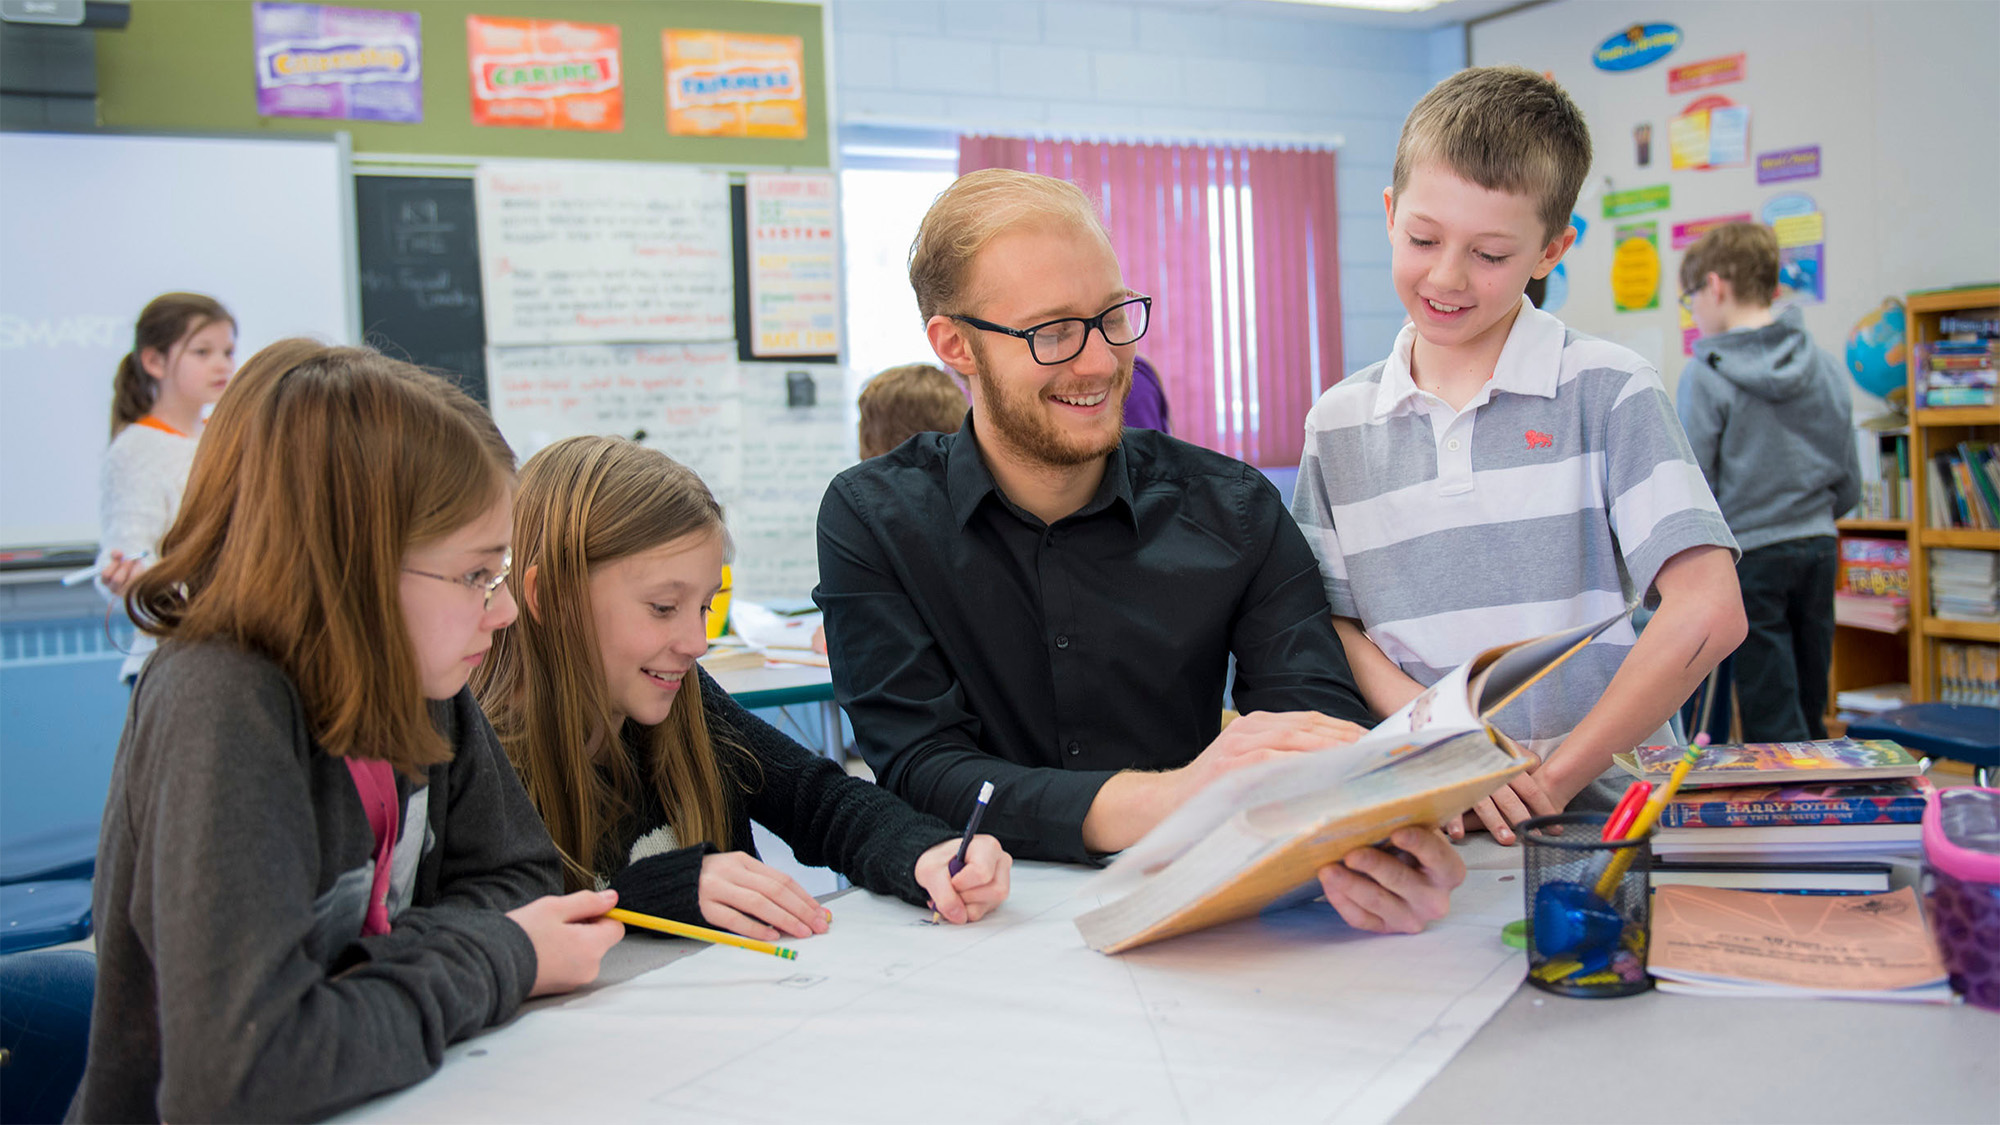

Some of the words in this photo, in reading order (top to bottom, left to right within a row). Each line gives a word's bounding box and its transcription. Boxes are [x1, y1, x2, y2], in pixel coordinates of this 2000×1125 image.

[493, 64, 600, 86] CARING
[0, 313, 128, 349] SMART
[1725, 802, 1785, 813] HARRY
[1791, 802, 1851, 811] POTTER
